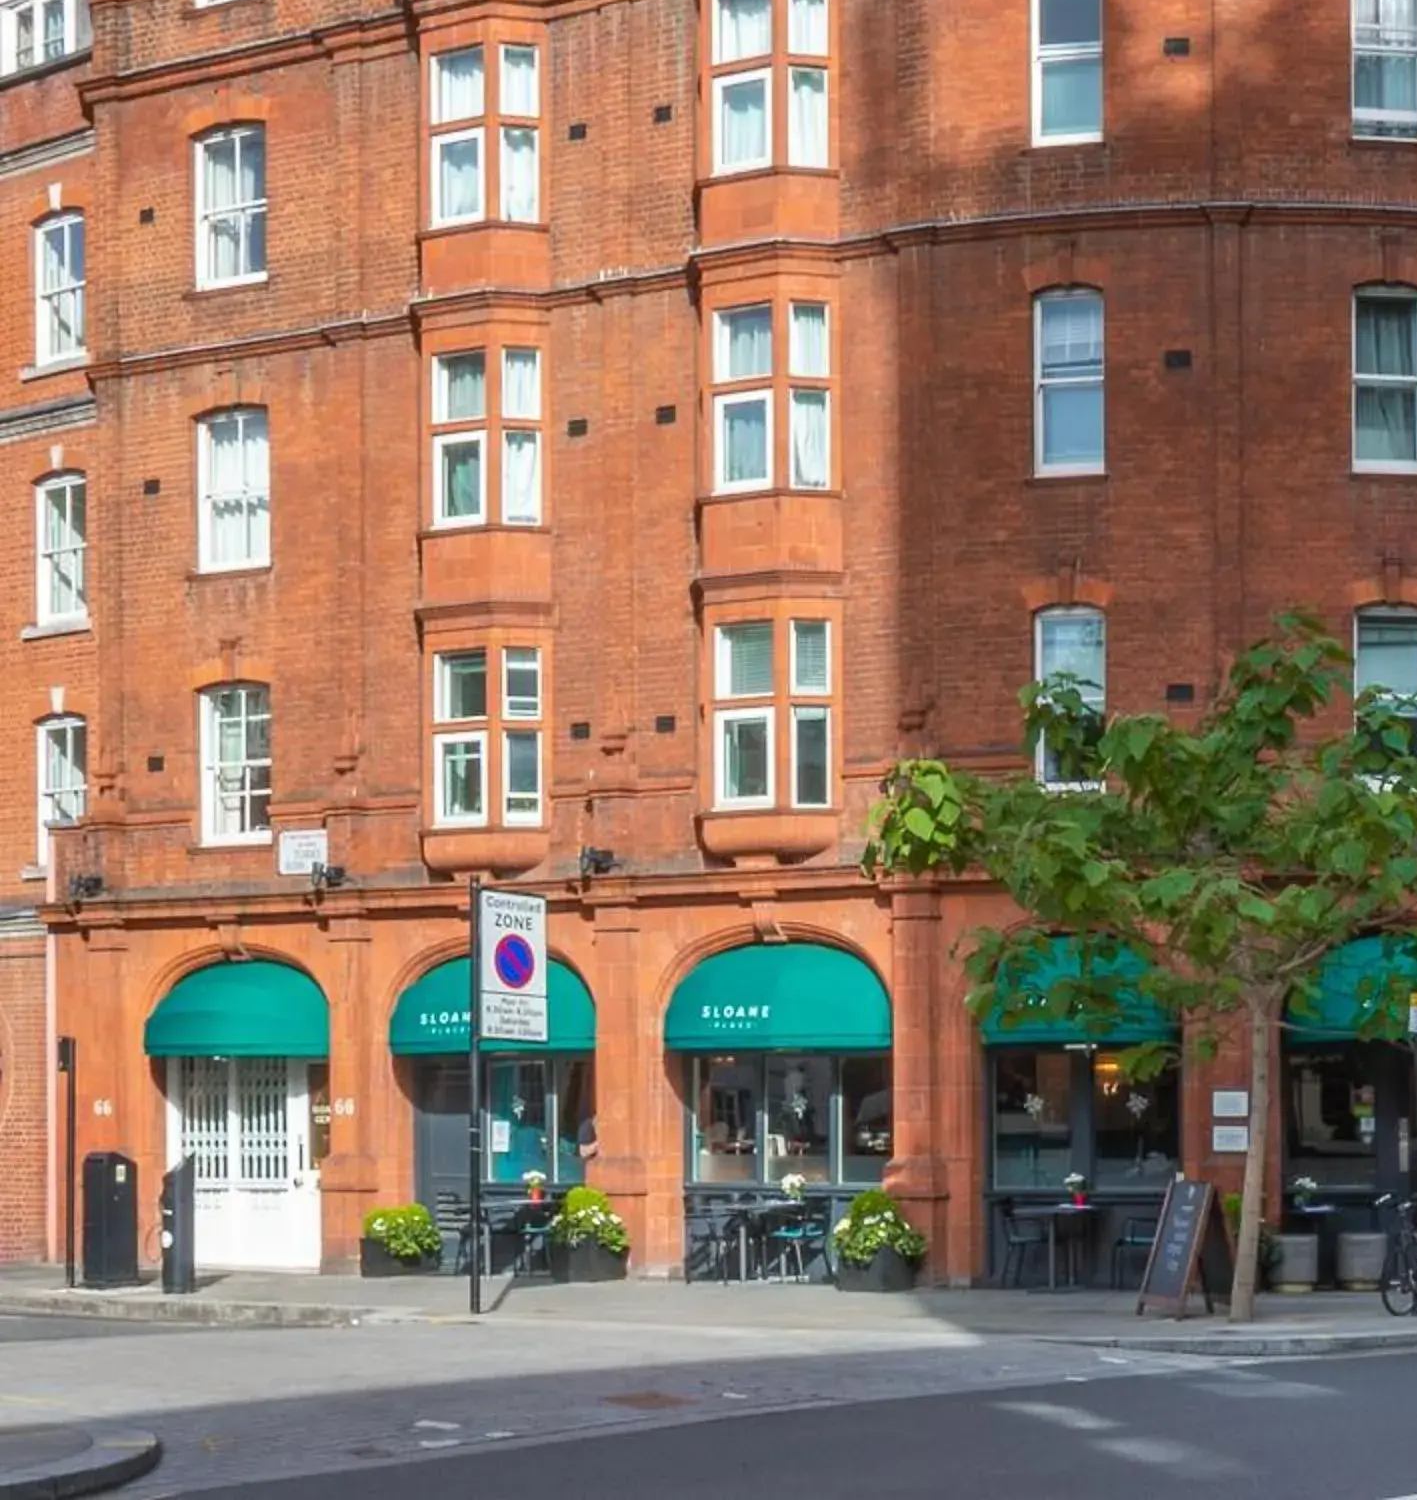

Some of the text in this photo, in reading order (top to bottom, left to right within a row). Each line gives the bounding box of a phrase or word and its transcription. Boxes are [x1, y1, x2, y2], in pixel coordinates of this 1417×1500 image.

[494, 912, 533, 931] ZONE
[420, 1011, 471, 1025] SLOAN
[701, 1004, 769, 1019] SLOANE
